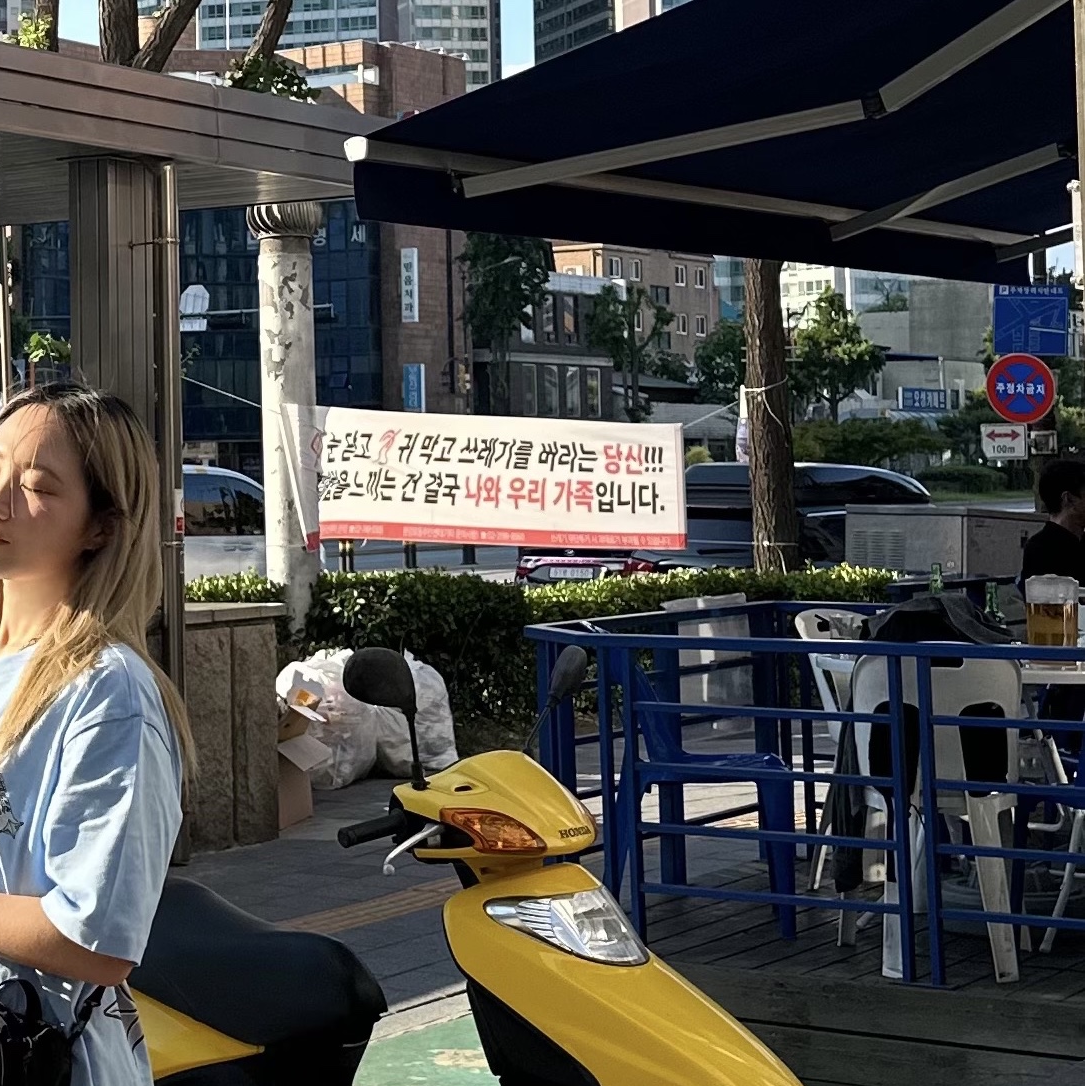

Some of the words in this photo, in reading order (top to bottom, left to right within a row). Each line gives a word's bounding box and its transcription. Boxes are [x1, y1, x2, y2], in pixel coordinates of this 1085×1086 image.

[995, 382, 1045, 395] 주정차금지
[398, 432, 420, 464] 귀
[419, 434, 457, 464] 막고
[457, 436, 533, 470] 쓰레기를
[538, 441, 598, 472] 버리는
[603, 443, 663, 475] 당신!!!
[992, 445, 1015, 454] 100m
[348, 468, 396, 501] 느끼는
[424, 471, 461, 506] 결국
[465, 473, 502, 509] 나와
[507, 477, 547, 511] 우리
[552, 478, 665, 514] 가족입니다.
[559, 825, 591, 838] HONDA
